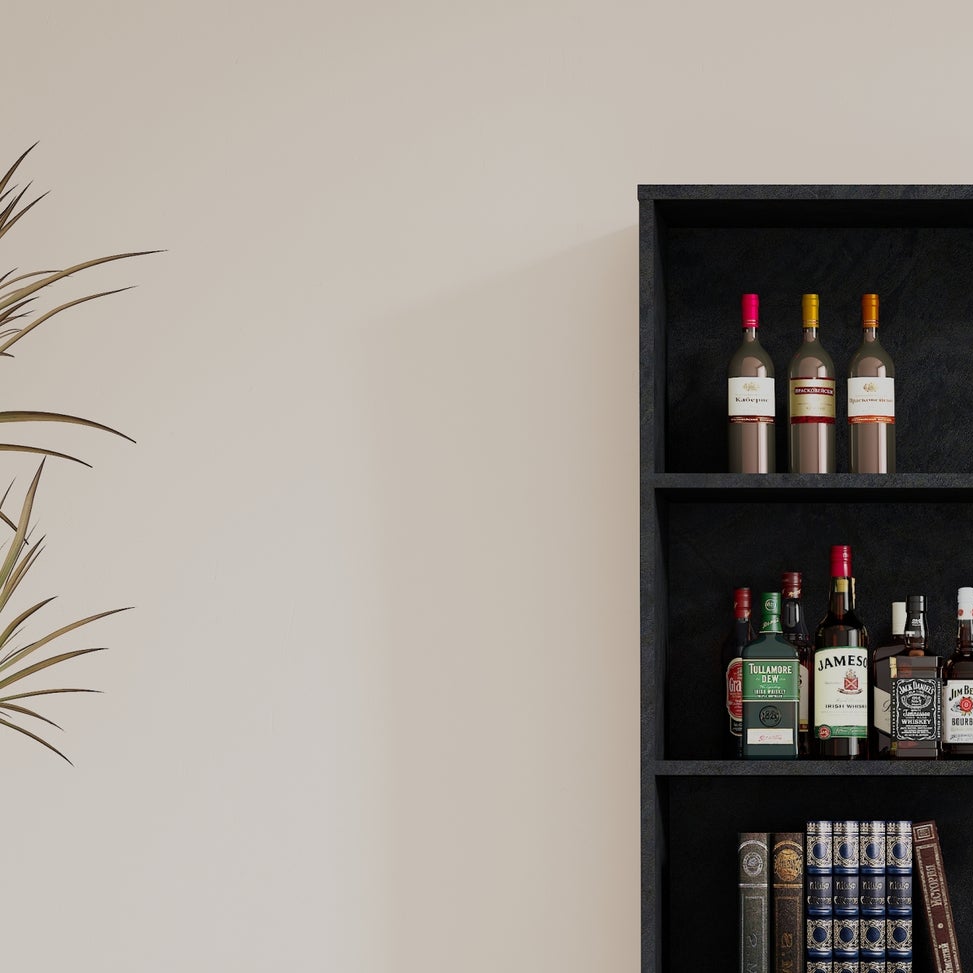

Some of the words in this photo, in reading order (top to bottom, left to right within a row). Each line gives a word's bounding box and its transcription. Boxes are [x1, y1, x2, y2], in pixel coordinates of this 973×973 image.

[748, 663, 792, 674] TULLAMORE
[729, 677, 742, 692] Gra
[761, 675, 779, 683] DEW
[948, 688, 963, 701] JIM
